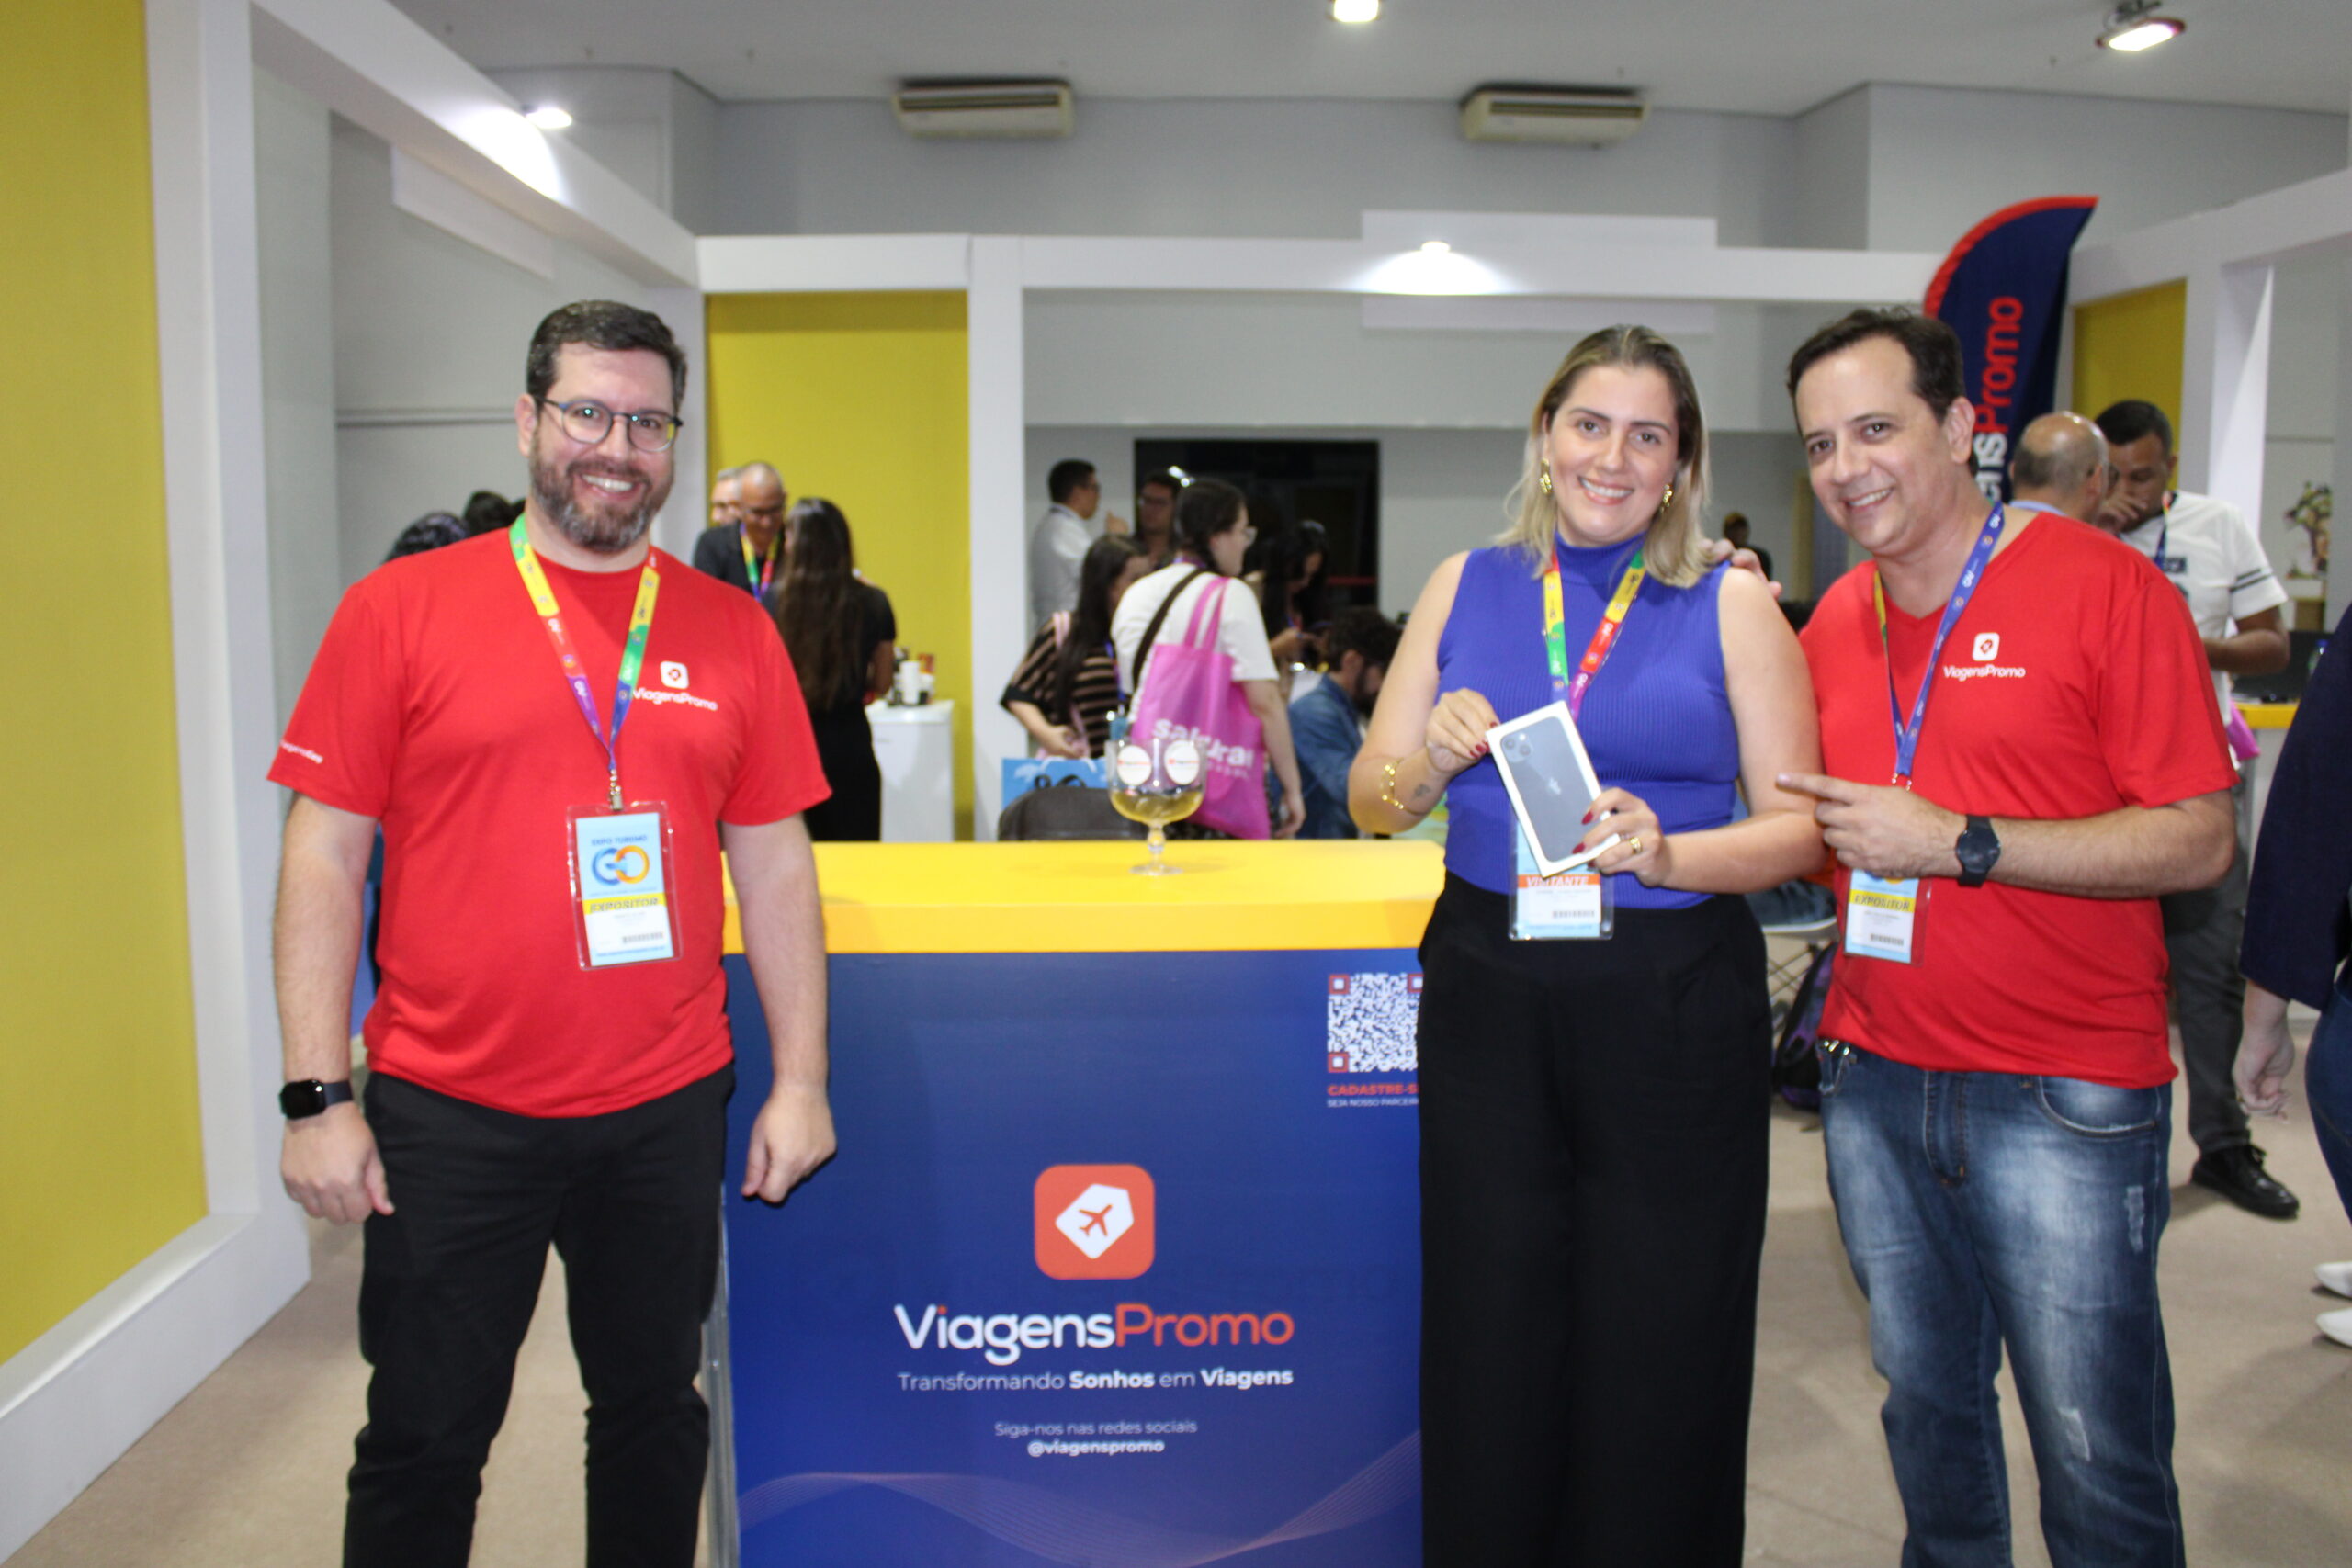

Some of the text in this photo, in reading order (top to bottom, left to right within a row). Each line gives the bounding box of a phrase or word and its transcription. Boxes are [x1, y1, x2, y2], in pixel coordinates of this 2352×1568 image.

[1942, 664, 2027, 682] ViagensPromo
[590, 897, 659, 914] EXPOSITOR
[1854, 894, 1910, 911] EXPOSITOR
[1328, 1083, 1419, 1096] CADASTRE-S
[894, 1303, 1295, 1366] ViagensPromo
[898, 1367, 1295, 1392] Transformando Sonhos em Viagens
[994, 1420, 1198, 1438] Siga-nos nas redes sociais
[1026, 1438, 1166, 1458] @viagenspromo
